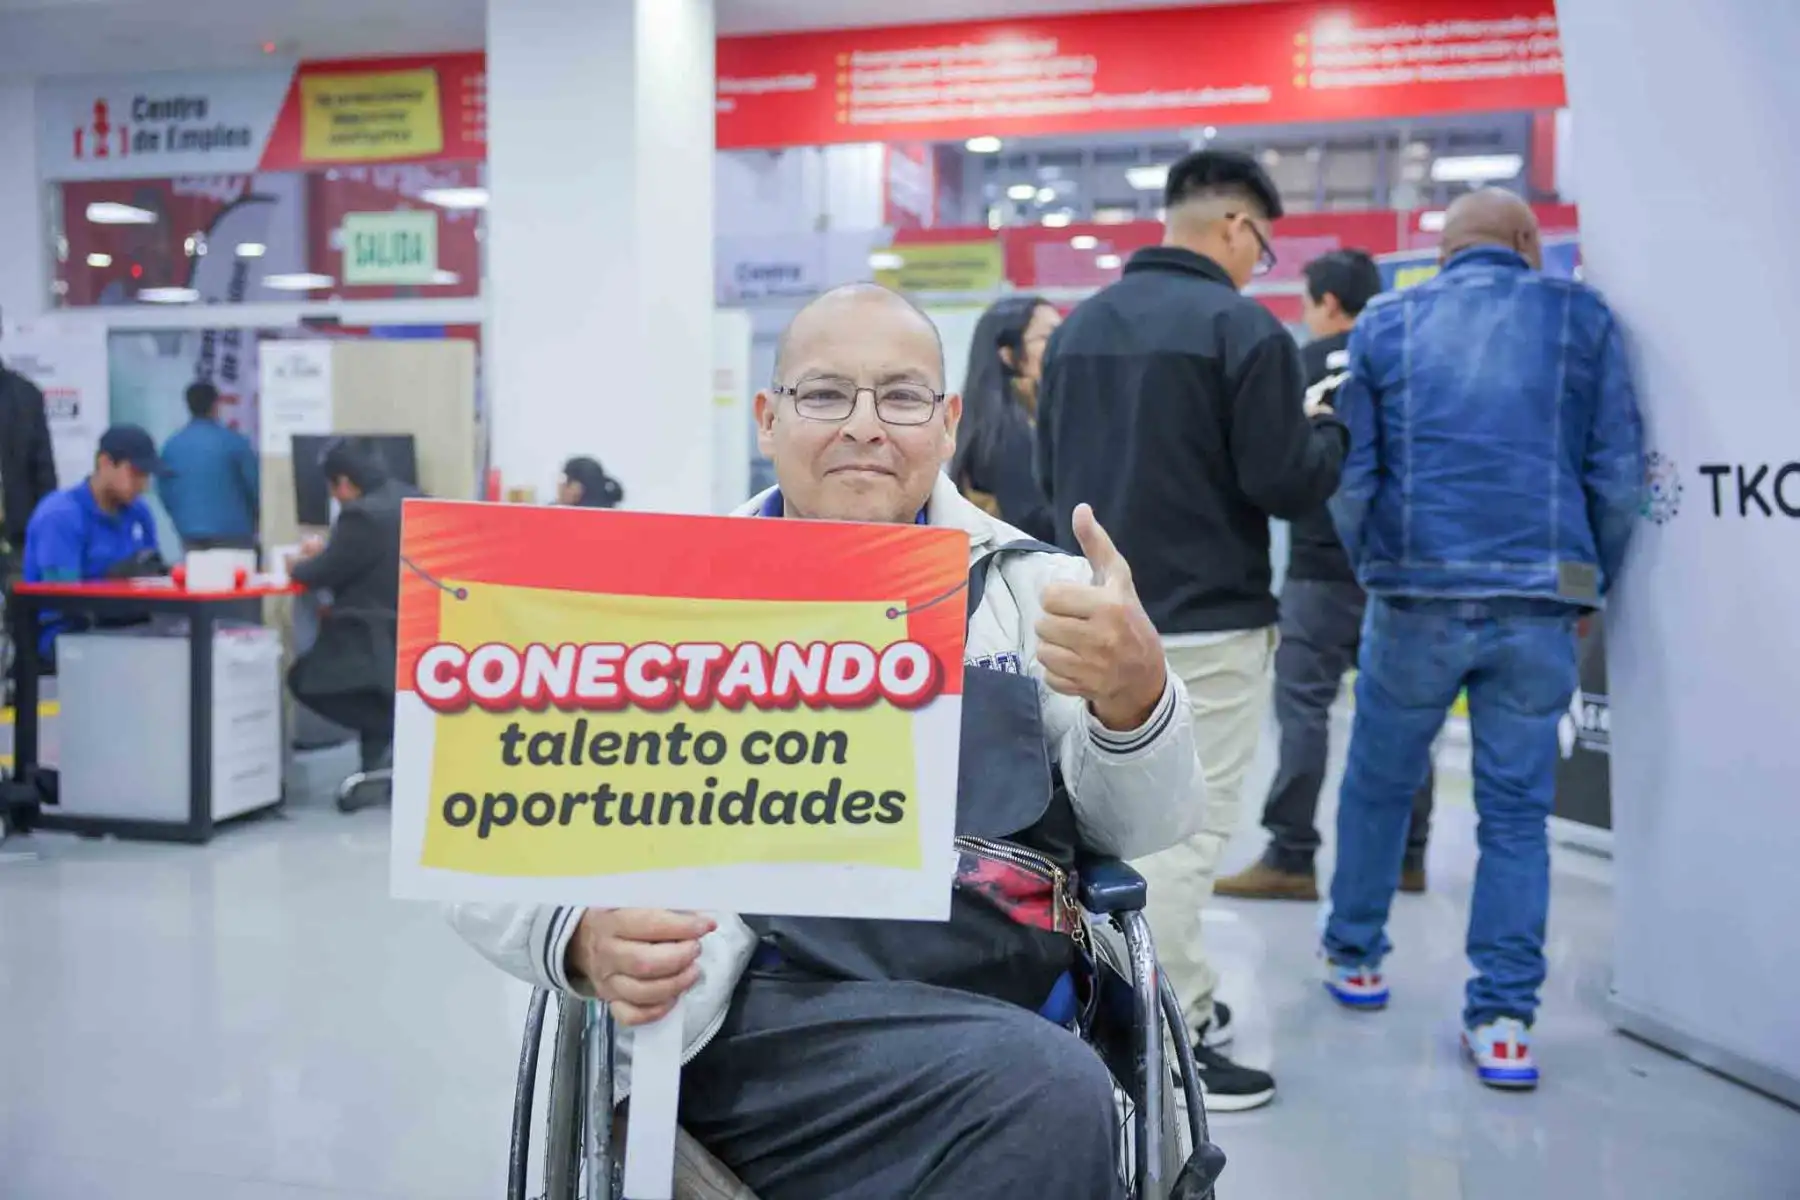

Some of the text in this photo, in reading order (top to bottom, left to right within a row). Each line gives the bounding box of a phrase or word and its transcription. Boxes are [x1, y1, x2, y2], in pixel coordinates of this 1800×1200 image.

[132, 94, 208, 121] Centro
[132, 123, 252, 153] de Empleo
[354, 230, 423, 267] SALIDA
[413, 640, 938, 708] CONECTANDO
[500, 718, 849, 767] talento con
[442, 777, 906, 840] oportunidades
